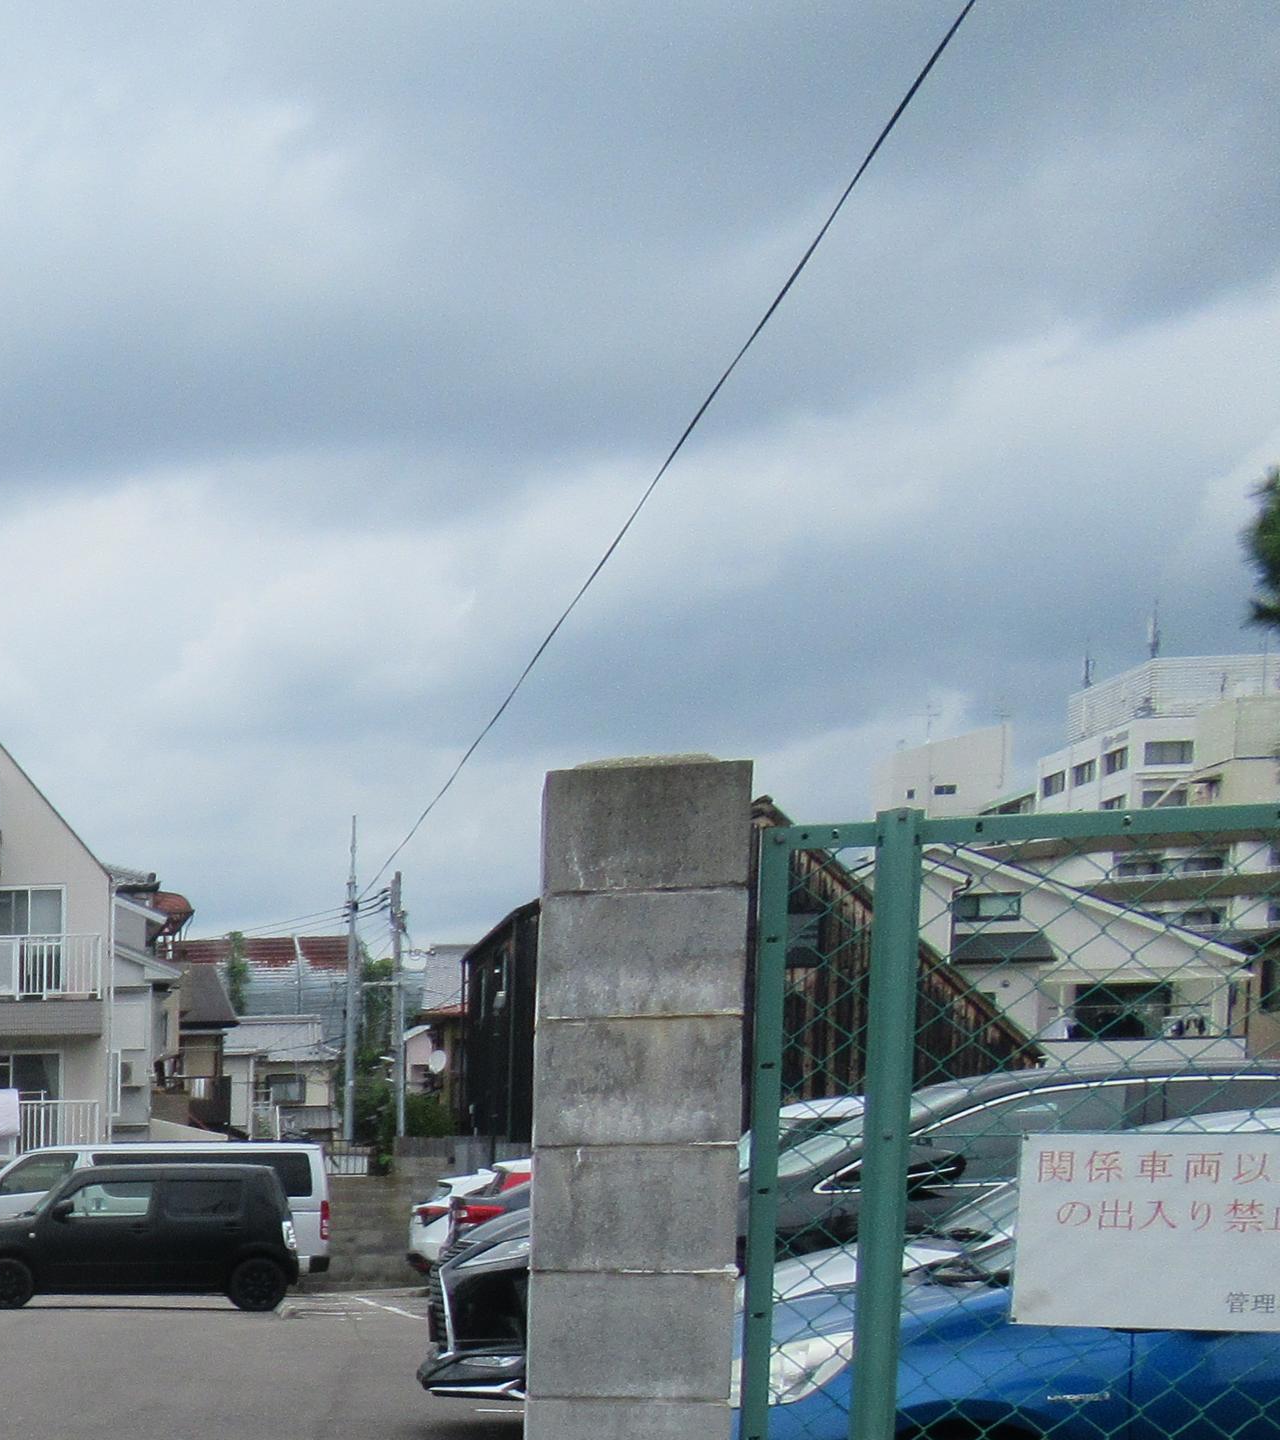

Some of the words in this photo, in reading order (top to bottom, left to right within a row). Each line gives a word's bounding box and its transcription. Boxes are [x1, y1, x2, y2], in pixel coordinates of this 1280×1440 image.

[1037, 1149, 1280, 1185] 関係車両以
[1225, 1292, 1280, 1314] 管理
